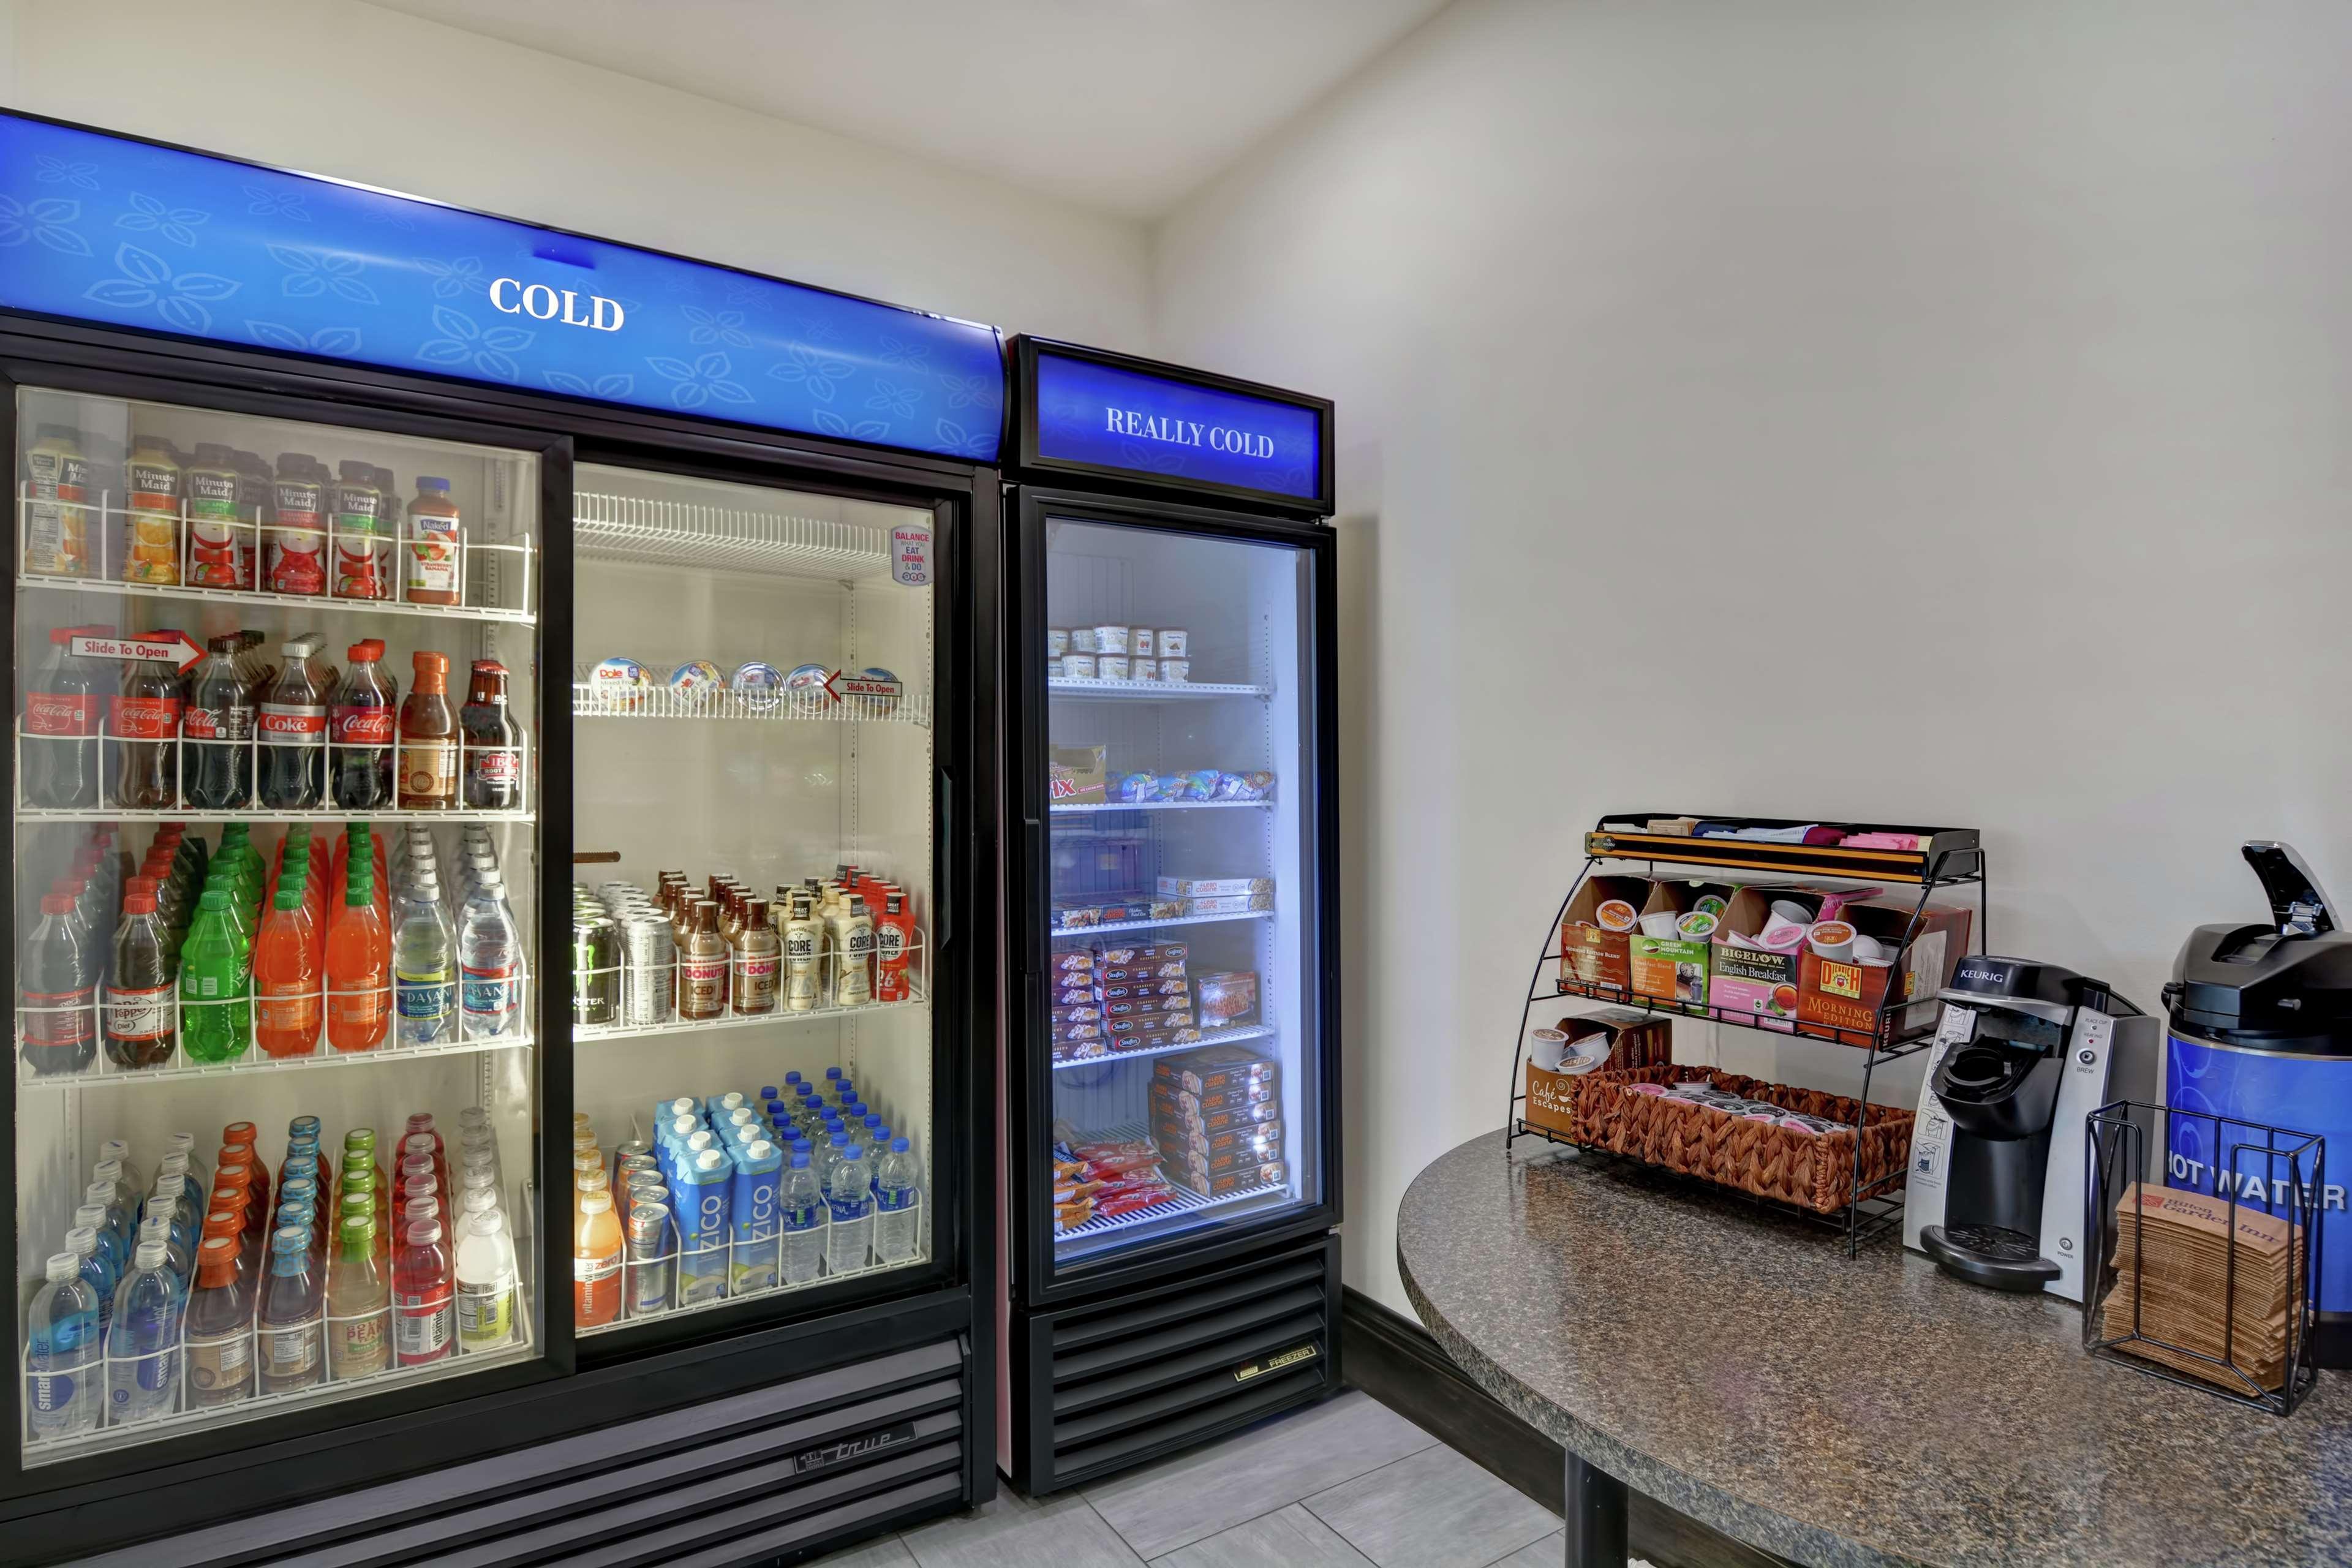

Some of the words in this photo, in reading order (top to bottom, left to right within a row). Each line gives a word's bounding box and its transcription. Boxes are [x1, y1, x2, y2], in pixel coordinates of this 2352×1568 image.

[489, 277, 624, 331] COLD
[1106, 407, 1205, 447] REALLY
[1209, 427, 1274, 459] COLD
[135, 469, 175, 483] Minute
[141, 480, 171, 491] Maid
[195, 477, 233, 489] Minute
[200, 486, 229, 497] Maid
[280, 489, 316, 499] Minute
[284, 497, 312, 507] Maid
[344, 494, 377, 505] Minute
[348, 502, 374, 513] Maid
[423, 521, 449, 531] Naked
[895, 532, 929, 541] BALANCE
[902, 554, 924, 563] DRINK
[85, 641, 115, 654] Slide
[119, 644, 132, 655] To
[136, 645, 168, 658] Open
[600, 669, 623, 677] Dole
[847, 682, 864, 692] Slide
[876, 685, 895, 694] Open
[266, 715, 307, 731] Coke
[788, 940, 811, 952] CORE
[850, 935, 869, 948] CORE
[879, 933, 900, 946] CORE
[1721, 947, 1785, 965] BIGELOW
[685, 967, 725, 979] DONUTS
[1719, 961, 1747, 976] English
[1748, 966, 1787, 982] Breakfast
[1960, 970, 2003, 983] KEURIG
[691, 986, 714, 995] ICED
[754, 980, 774, 990] ICED
[407, 987, 452, 1004] DASANI
[1821, 986, 1860, 999] COFFEE
[1807, 997, 1874, 1021] MORNING
[1823, 1012, 1873, 1030] EDITION
[1882, 1009, 1893, 1047] KEURI
[2076, 1066, 2095, 1075] BREW
[1532, 1080, 1556, 1102] Café
[1532, 1096, 1571, 1114] Escapes
[2211, 1167, 2346, 1210] WATER
[2166, 1198, 2212, 1213] Hilton
[752, 1185, 773, 1241] ZICO
[700, 1195, 722, 1250] ZICO
[2163, 1203, 2231, 1226] Garden
[2239, 1224, 2281, 1243] Inn
[2057, 1251, 2073, 1259] POWER
[595, 1256, 617, 1270] zero
[1269, 1349, 1310, 1368] FREEZER
